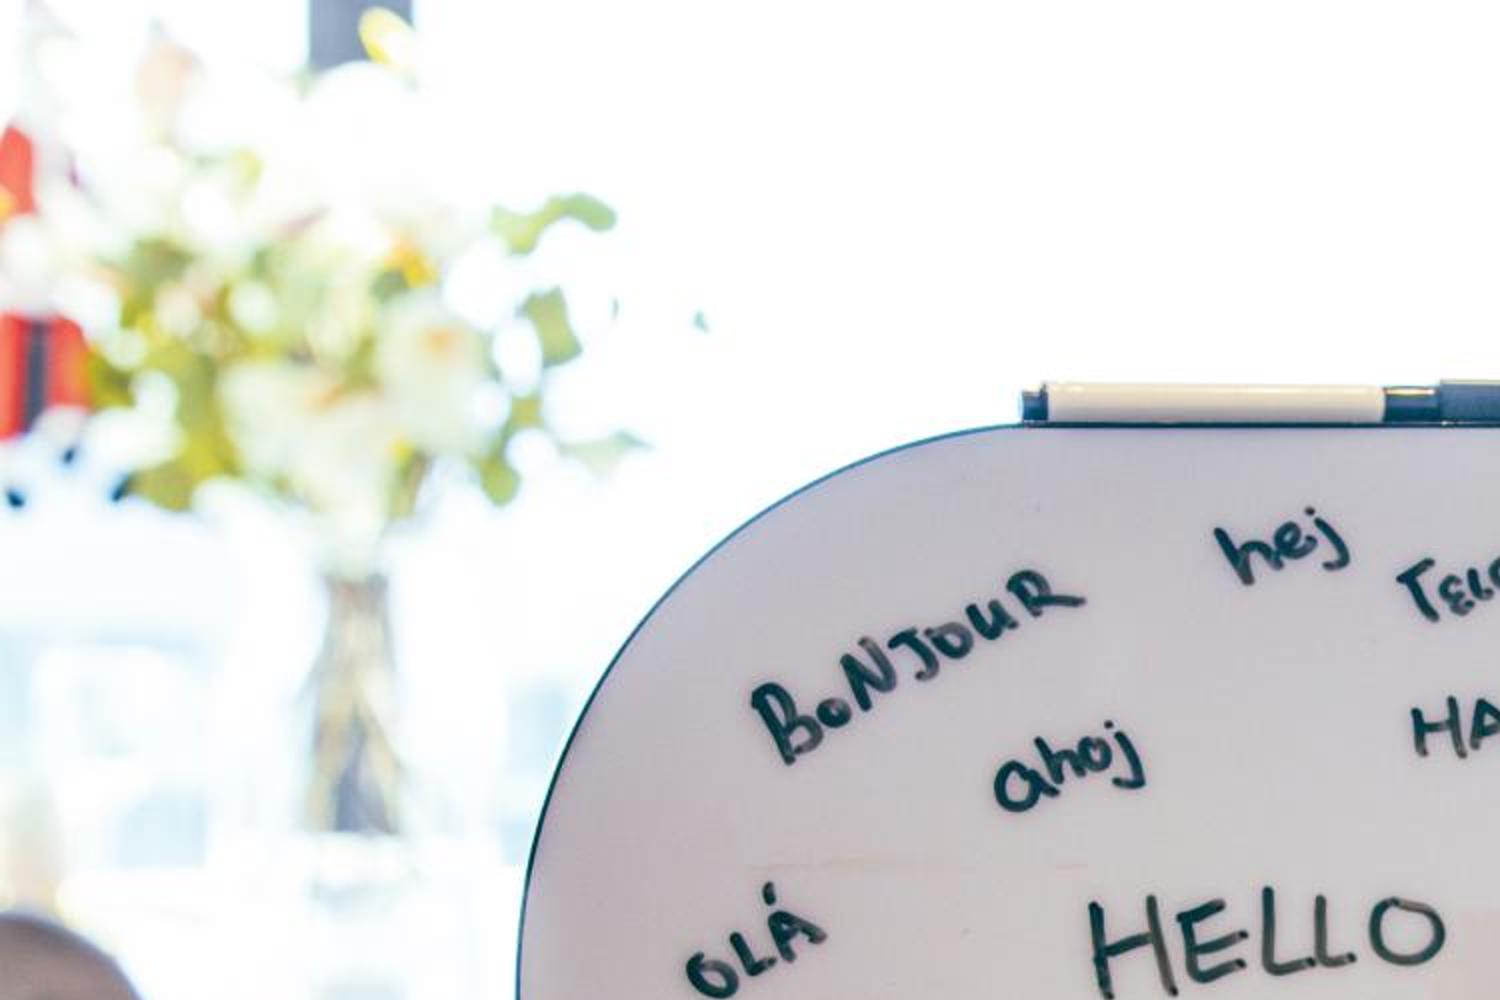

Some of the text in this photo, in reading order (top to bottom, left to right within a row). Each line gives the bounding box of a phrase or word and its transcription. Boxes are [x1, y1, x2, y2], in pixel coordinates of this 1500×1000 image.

[1212, 506, 1351, 587] hej
[992, 719, 1147, 814] ahoj
[684, 881, 828, 1000] OLÁ
